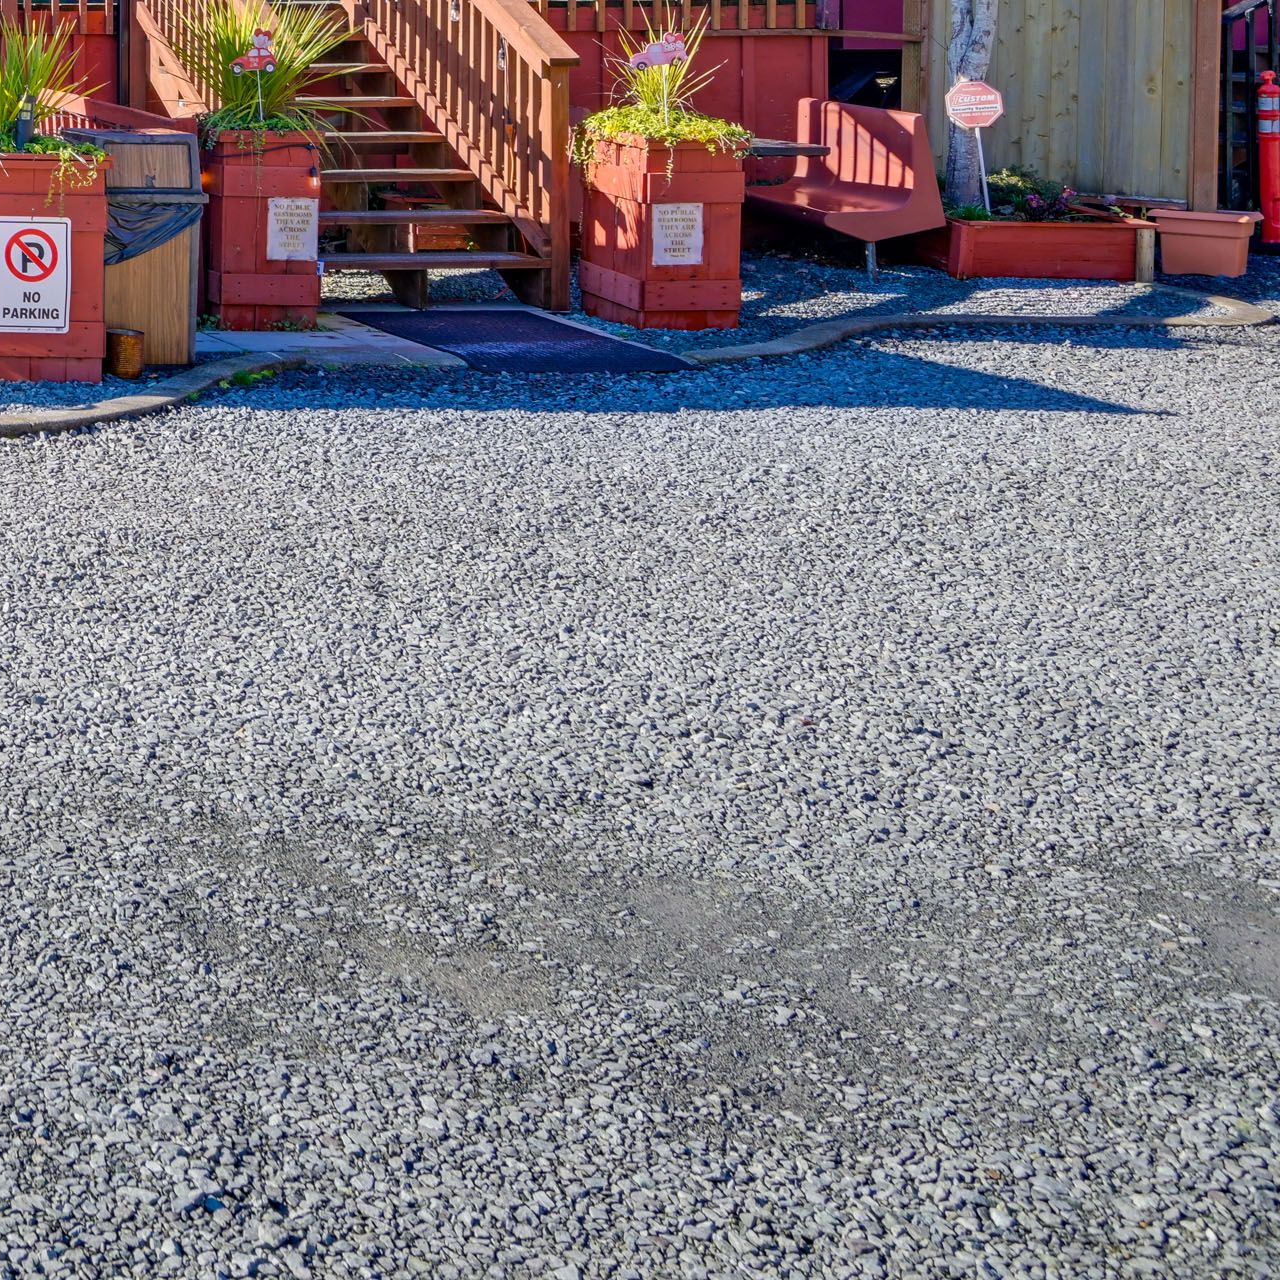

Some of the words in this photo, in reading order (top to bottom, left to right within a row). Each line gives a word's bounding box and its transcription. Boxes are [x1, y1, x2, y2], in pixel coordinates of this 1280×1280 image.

[958, 94, 995, 103] CUSTOM
[22, 291, 41, 303] NO
[2, 307, 60, 320] PARKING
